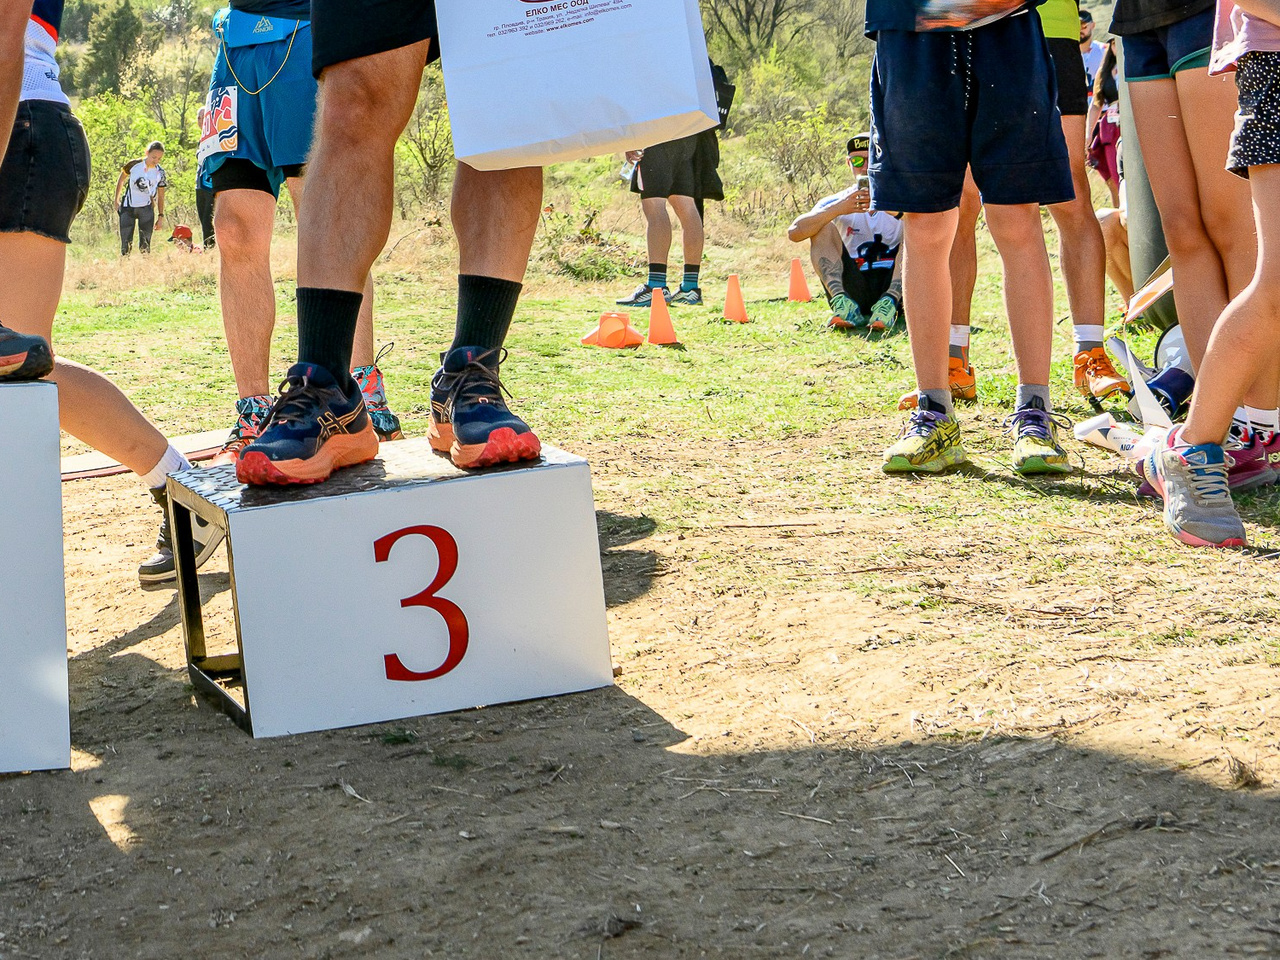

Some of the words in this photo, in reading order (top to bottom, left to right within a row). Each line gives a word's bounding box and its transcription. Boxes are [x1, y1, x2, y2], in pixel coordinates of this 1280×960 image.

[525, 7, 549, 18] ЕЛКО
[550, 2, 569, 12] МЕС
[373, 524, 470, 681] 3
